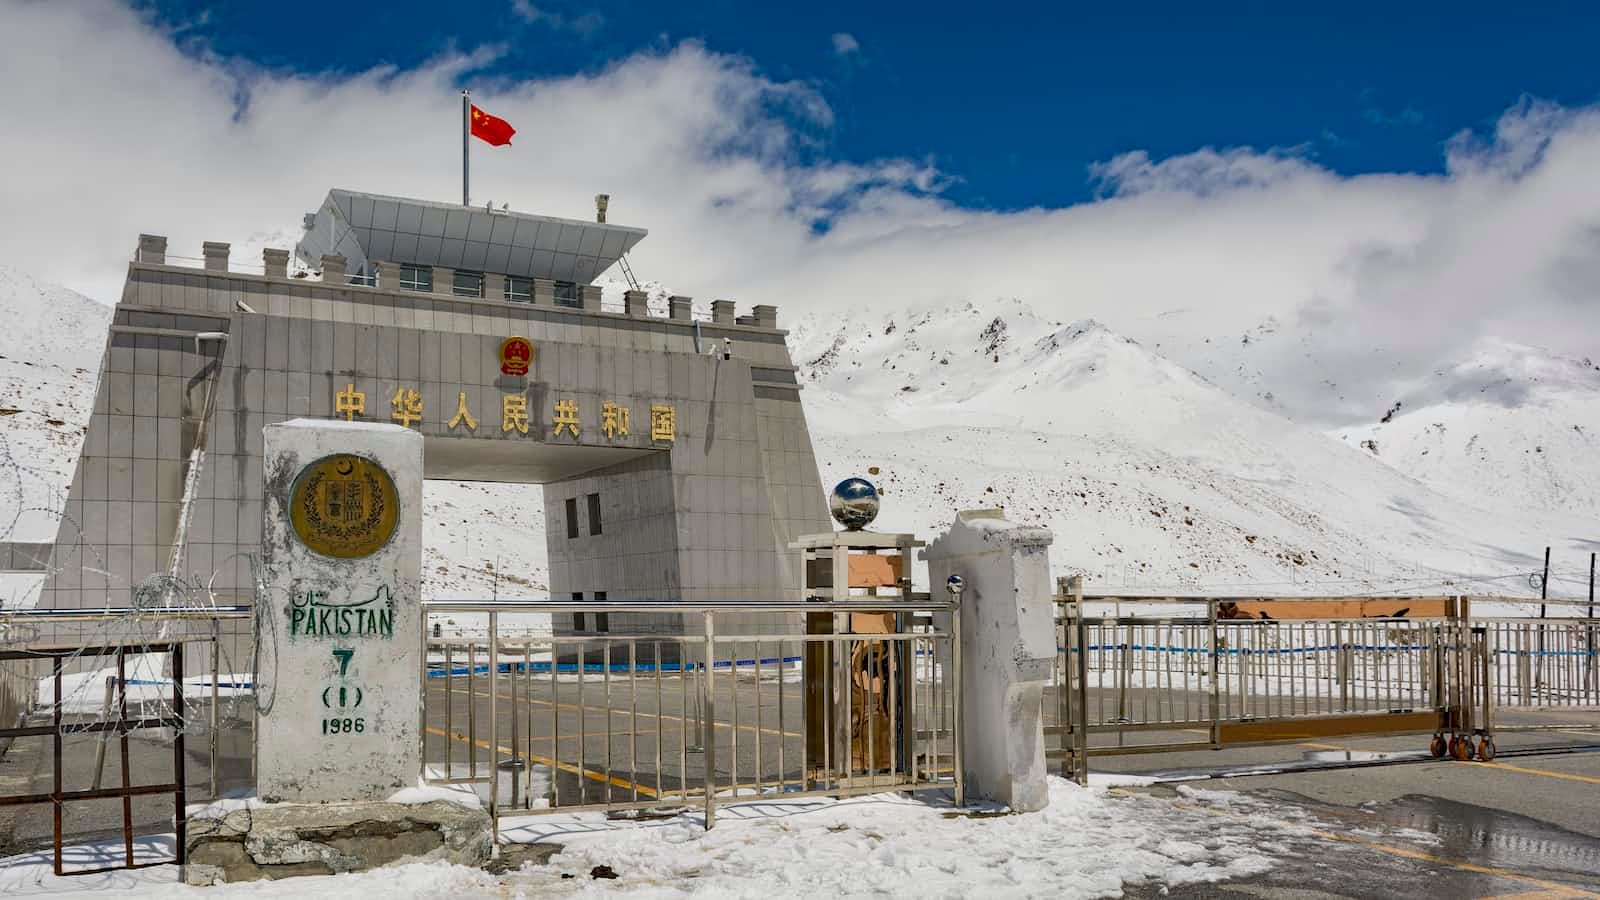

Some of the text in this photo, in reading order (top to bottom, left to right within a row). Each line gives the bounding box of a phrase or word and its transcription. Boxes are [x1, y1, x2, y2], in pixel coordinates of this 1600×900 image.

[336, 383, 676, 442] 中华人民共和国
[291, 608, 392, 636] PAKISTAN
[332, 649, 354, 676] 7
[322, 717, 365, 735] 1986
